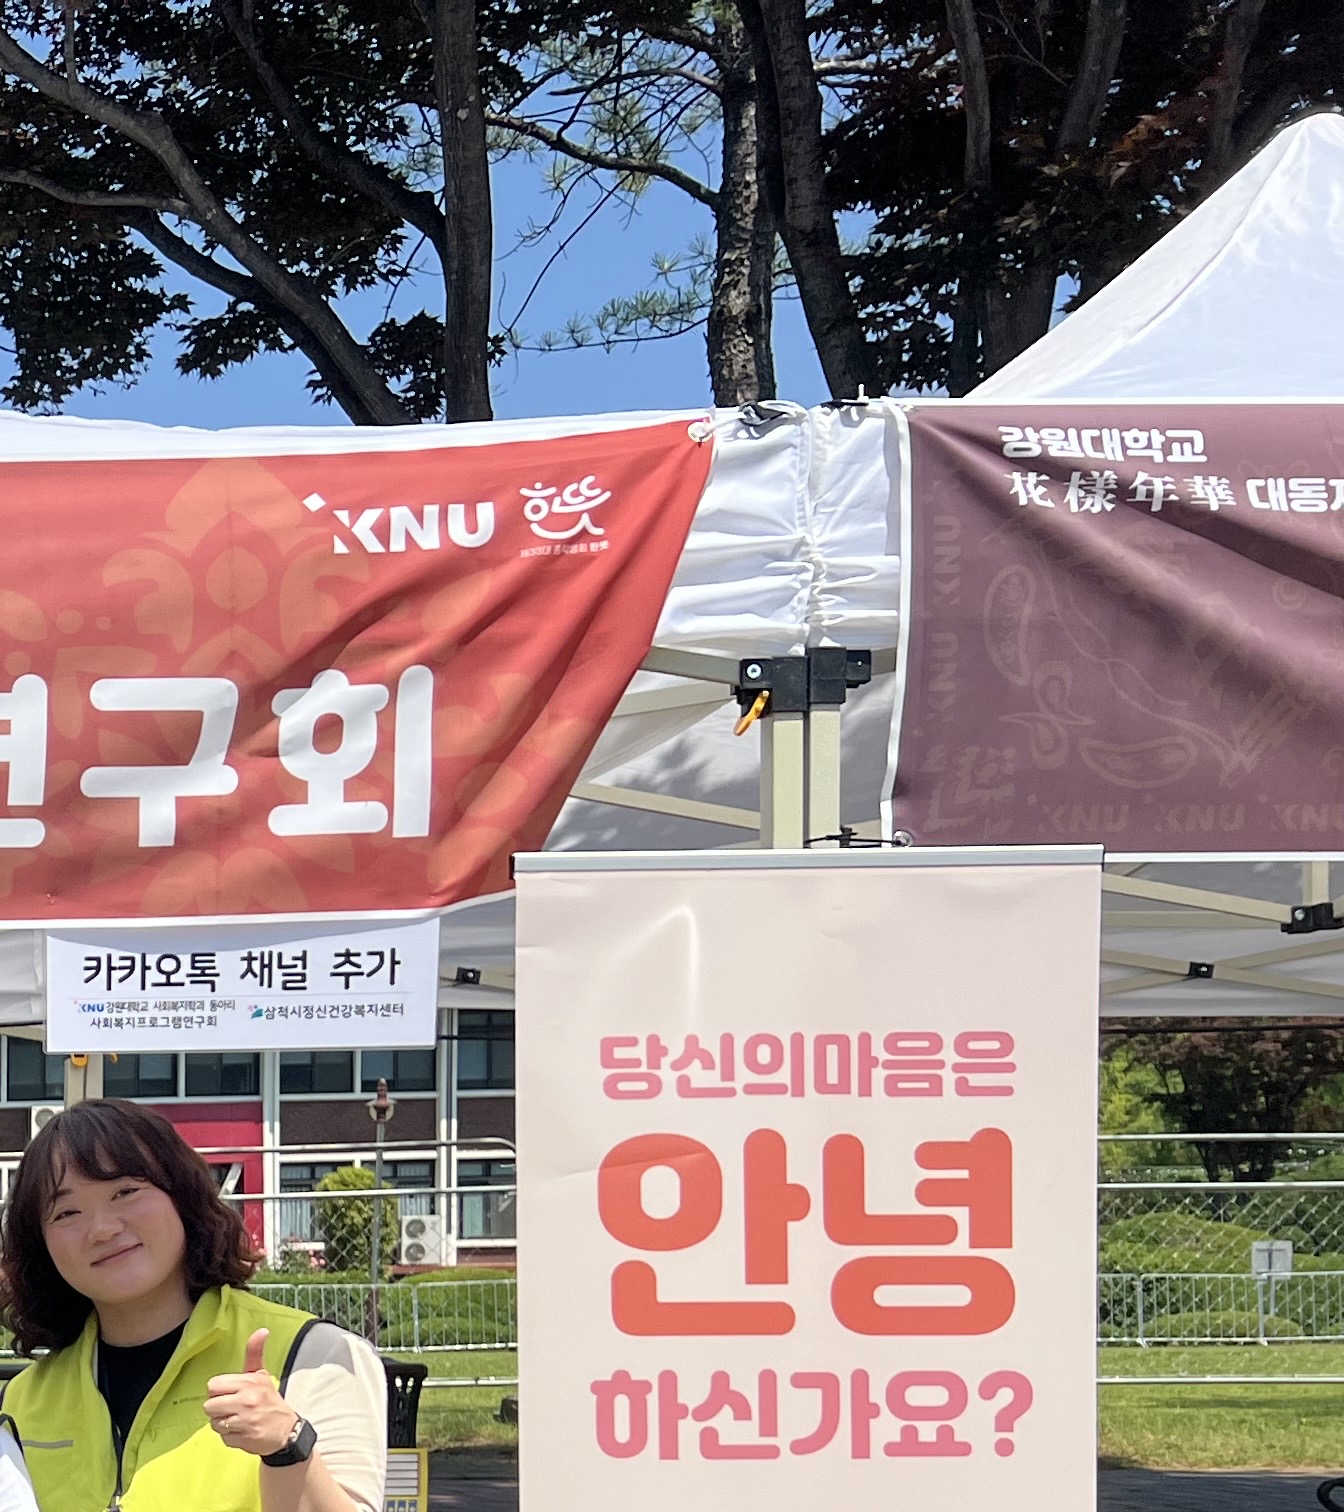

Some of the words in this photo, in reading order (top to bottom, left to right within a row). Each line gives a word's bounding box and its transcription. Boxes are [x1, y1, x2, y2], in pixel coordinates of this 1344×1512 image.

[998, 425, 1207, 463] 강원대학교
[1004, 470, 1237, 514] 花樣年華
[333, 501, 494, 554] KNU
[83, 952, 220, 991] 카카오톡
[240, 949, 308, 991] 채널
[330, 947, 401, 990] 추가
[90, 1016, 217, 1029] 사회복지프로그램연구회
[106, 1001, 148, 1013] 강원대학교
[153, 1000, 205, 1012] 사회복지학과
[209, 1000, 235, 1011] 동아리
[264, 1002, 404, 1020] 삼척시정신건강복지센터
[599, 1030, 1017, 1100] 당신의마음은
[596, 1126, 1016, 1336] 안녕
[590, 1368, 1034, 1460] 하신가요?
